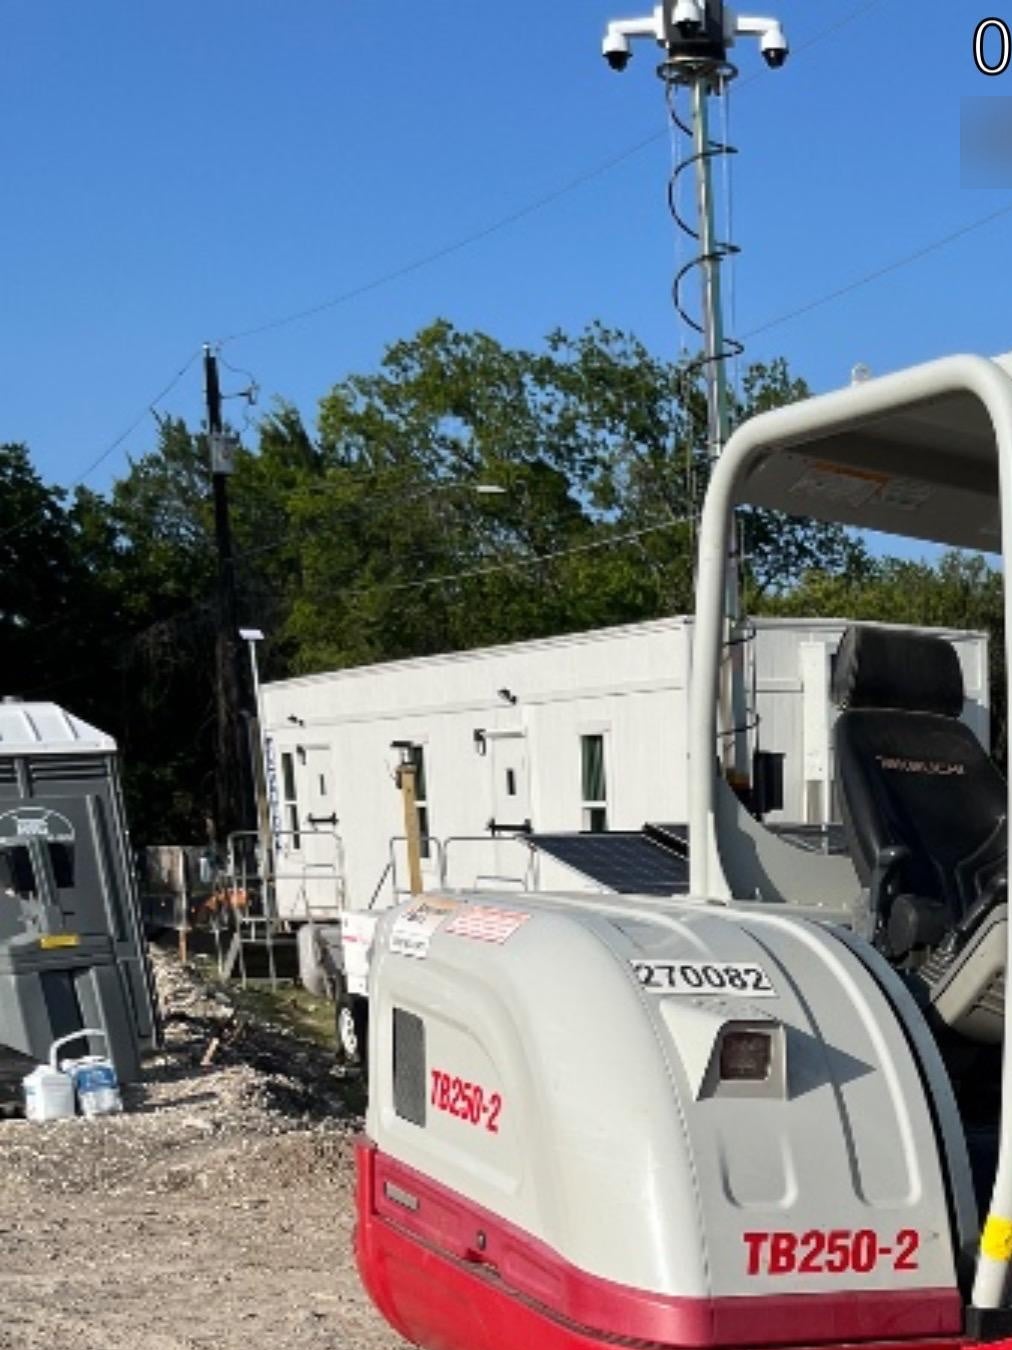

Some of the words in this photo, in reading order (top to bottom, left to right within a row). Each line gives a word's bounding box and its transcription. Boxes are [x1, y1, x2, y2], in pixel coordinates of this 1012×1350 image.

[633, 963, 774, 990] 270082
[431, 1070, 502, 1132] TB250-2
[743, 1230, 919, 1275] TB250-2
